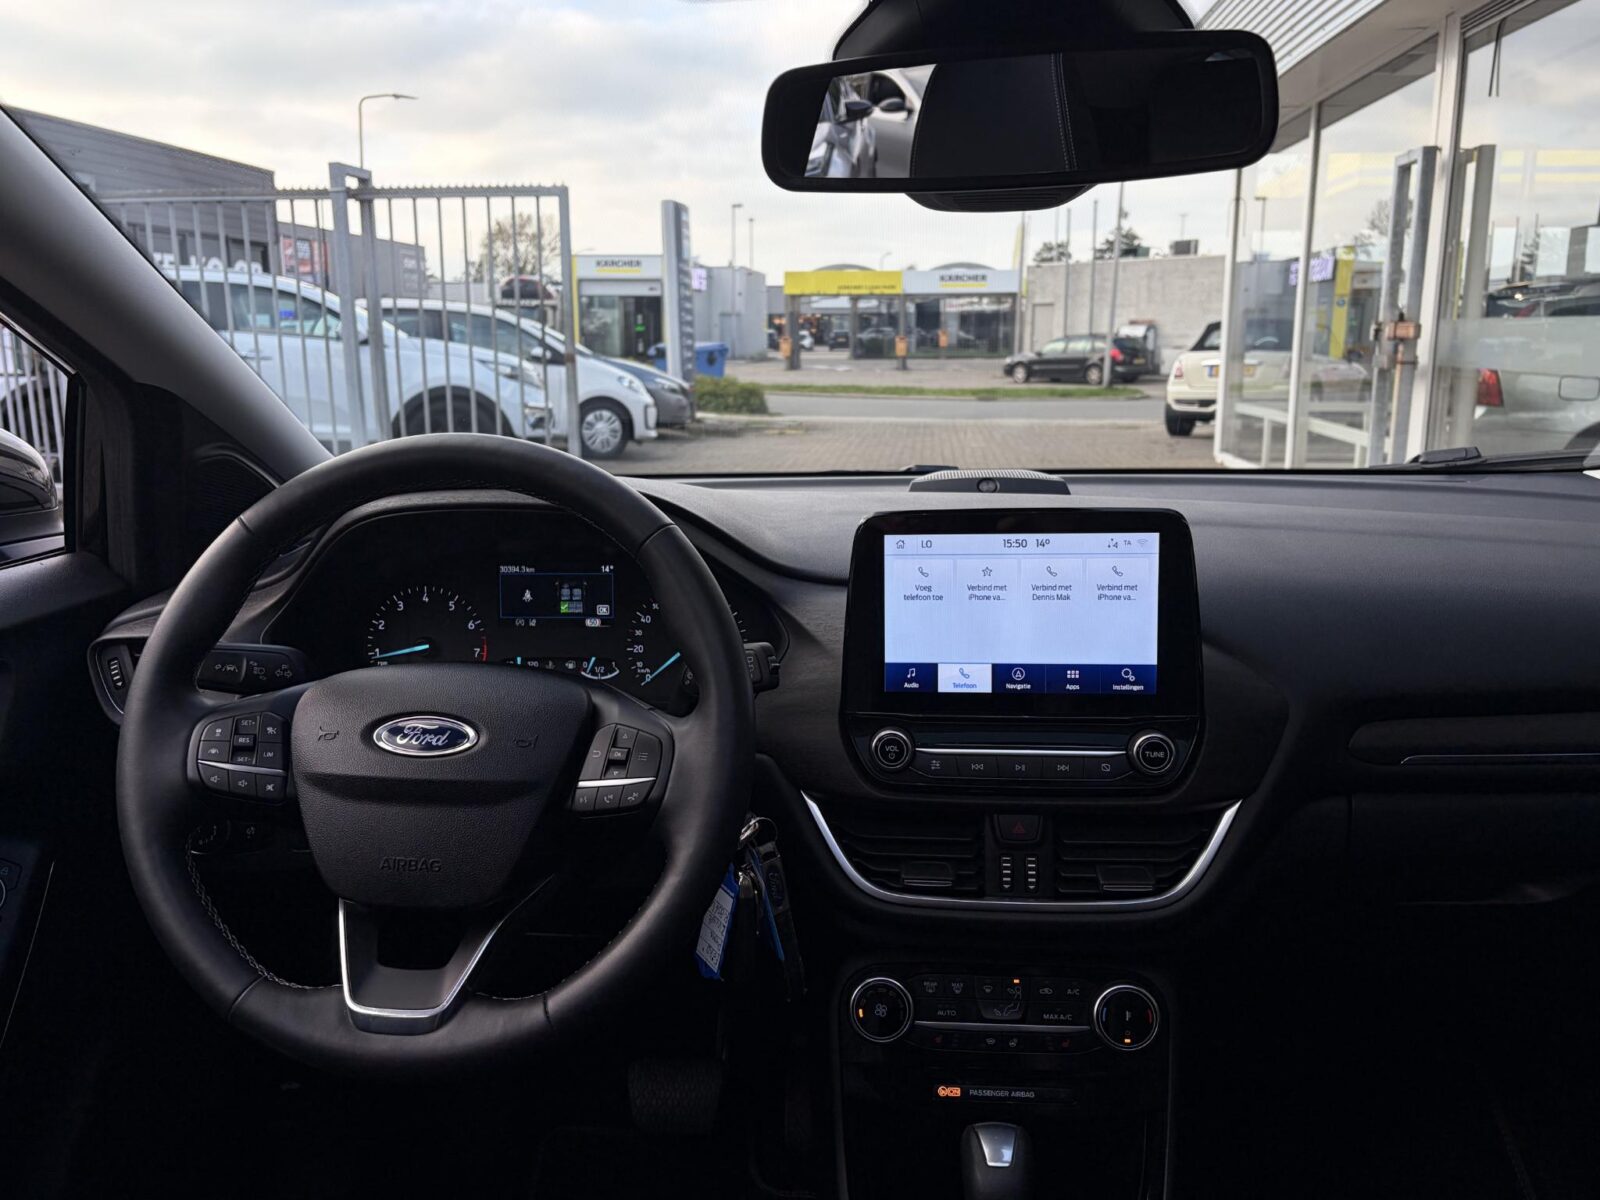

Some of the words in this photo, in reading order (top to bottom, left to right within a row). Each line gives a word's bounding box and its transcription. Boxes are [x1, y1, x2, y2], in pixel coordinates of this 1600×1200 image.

[920, 539, 933, 549] LO
[1002, 538, 1028, 549] 15:50
[915, 584, 933, 593] Voeg
[966, 583, 992, 592] Verbind
[993, 584, 1008, 592] met
[1031, 583, 1057, 592] Verbind
[1058, 584, 1073, 592] met
[1096, 583, 1122, 592] Verbind
[1123, 584, 1139, 592] met
[903, 593, 931, 602] telefoon
[932, 594, 944, 602] toe
[968, 593, 991, 602] iPhone
[1032, 593, 1055, 602] Dennis
[1056, 593, 1072, 602] Mak
[1097, 593, 1121, 602] iPhone
[640, 615, 652, 624] 40
[633, 644, 644, 653] 20
[952, 682, 978, 690] Telefoon
[1005, 683, 1032, 691] Navigatie
[1065, 684, 1080, 692] Apps
[1112, 683, 1144, 692] Instellingen
[396, 723, 451, 746] Ford
[885, 744, 900, 752] VOL
[380, 857, 442, 873] AIRBAG
[969, 1089, 1009, 1098] PASSENGER
[1010, 1090, 1036, 1099] AIRBAG
